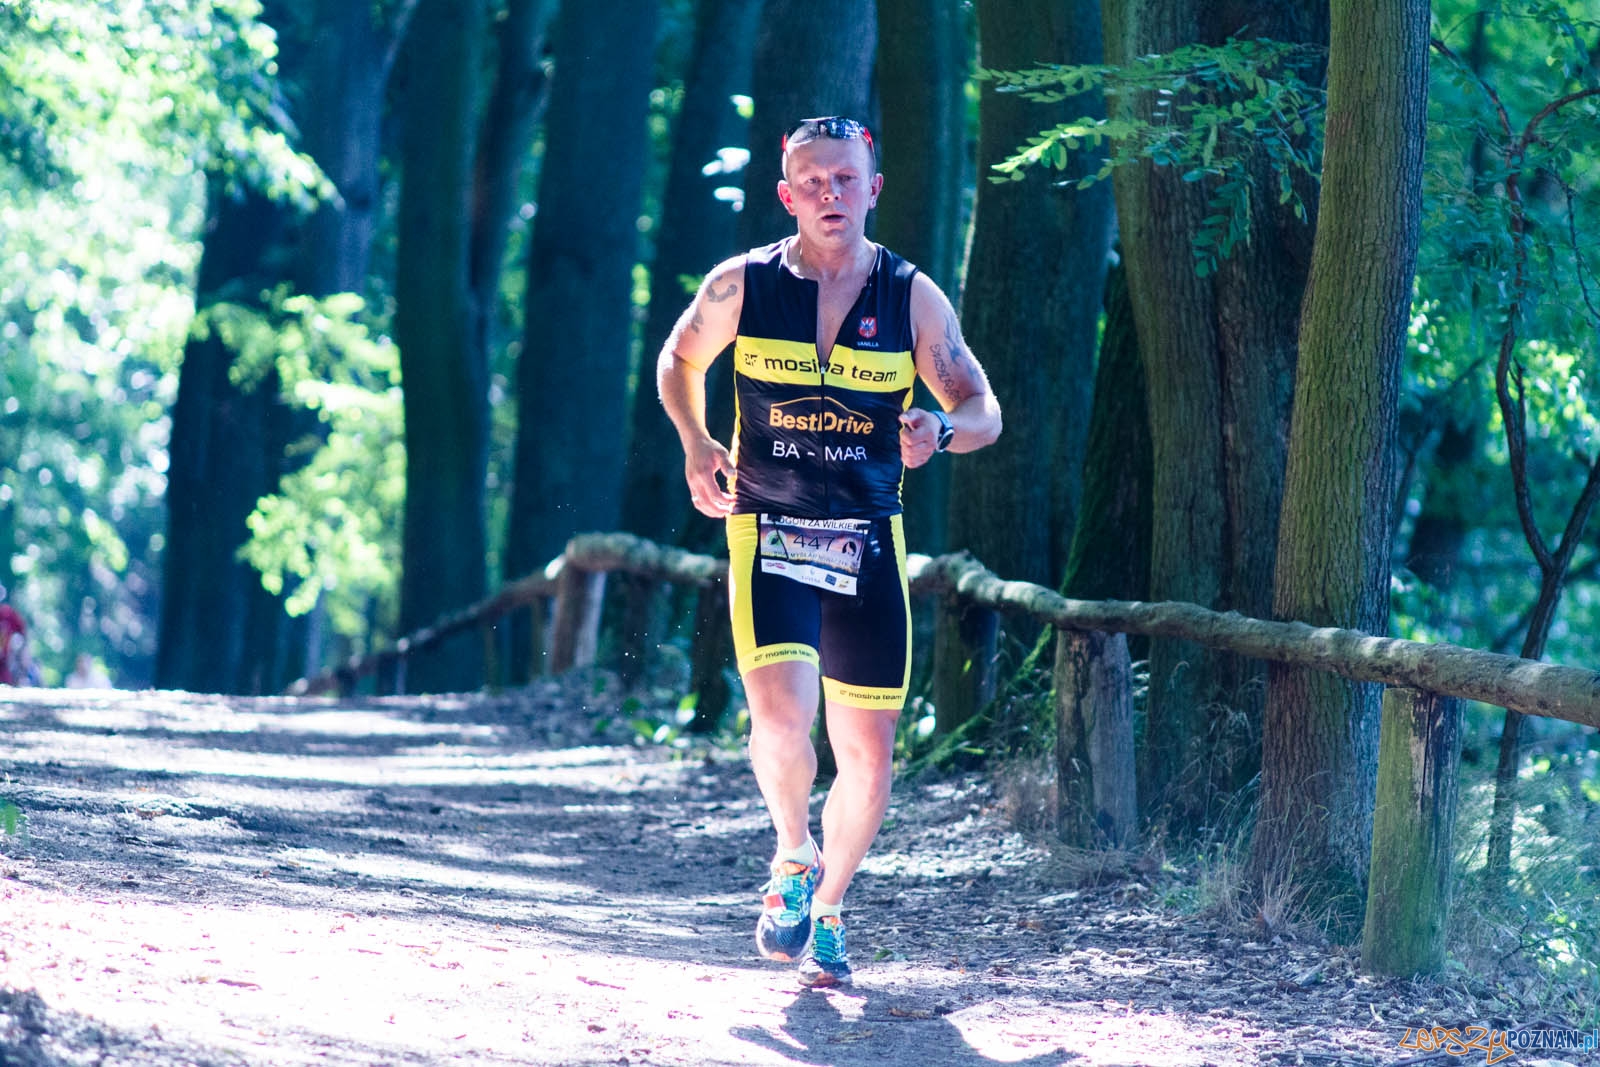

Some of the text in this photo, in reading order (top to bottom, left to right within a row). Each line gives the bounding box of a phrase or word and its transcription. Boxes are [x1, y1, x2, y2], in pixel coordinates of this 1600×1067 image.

[851, 365, 897, 382] team
[769, 409, 874, 434] BestDrive
[772, 440, 801, 459] BA
[825, 446, 867, 461] MAR
[808, 519, 820, 527] ZA
[793, 534, 836, 552] 447
[849, 691, 880, 700] mosina
